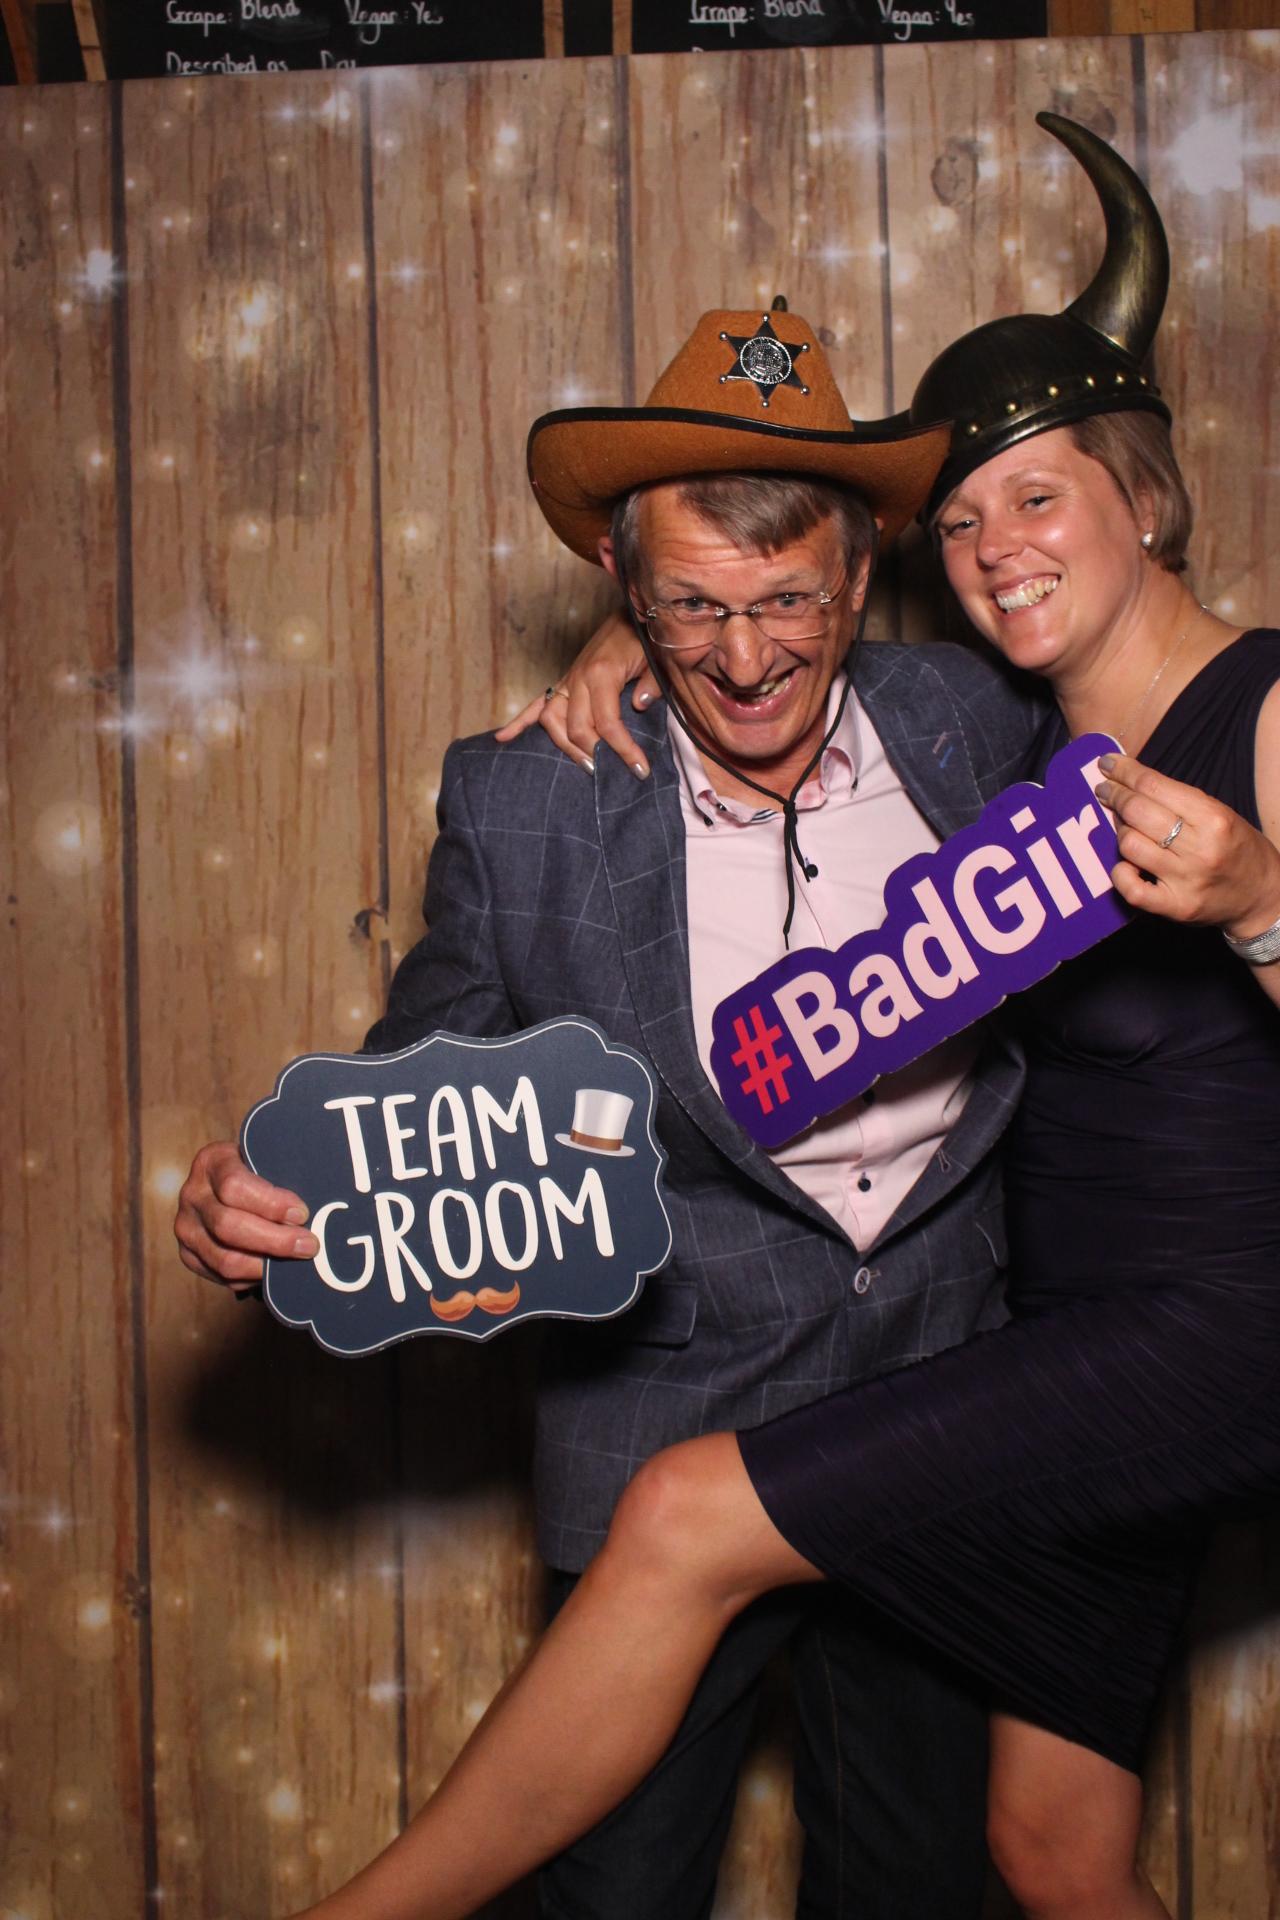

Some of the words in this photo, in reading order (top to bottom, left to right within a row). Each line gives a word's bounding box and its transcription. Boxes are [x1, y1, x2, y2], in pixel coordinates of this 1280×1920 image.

[241, 0, 301, 20] Blend
[764, 0, 826, 17] Blend
[944, 0, 975, 26] Yes
[324, 1076, 548, 1193] TEAM
[310, 1167, 615, 1302] GROOM
